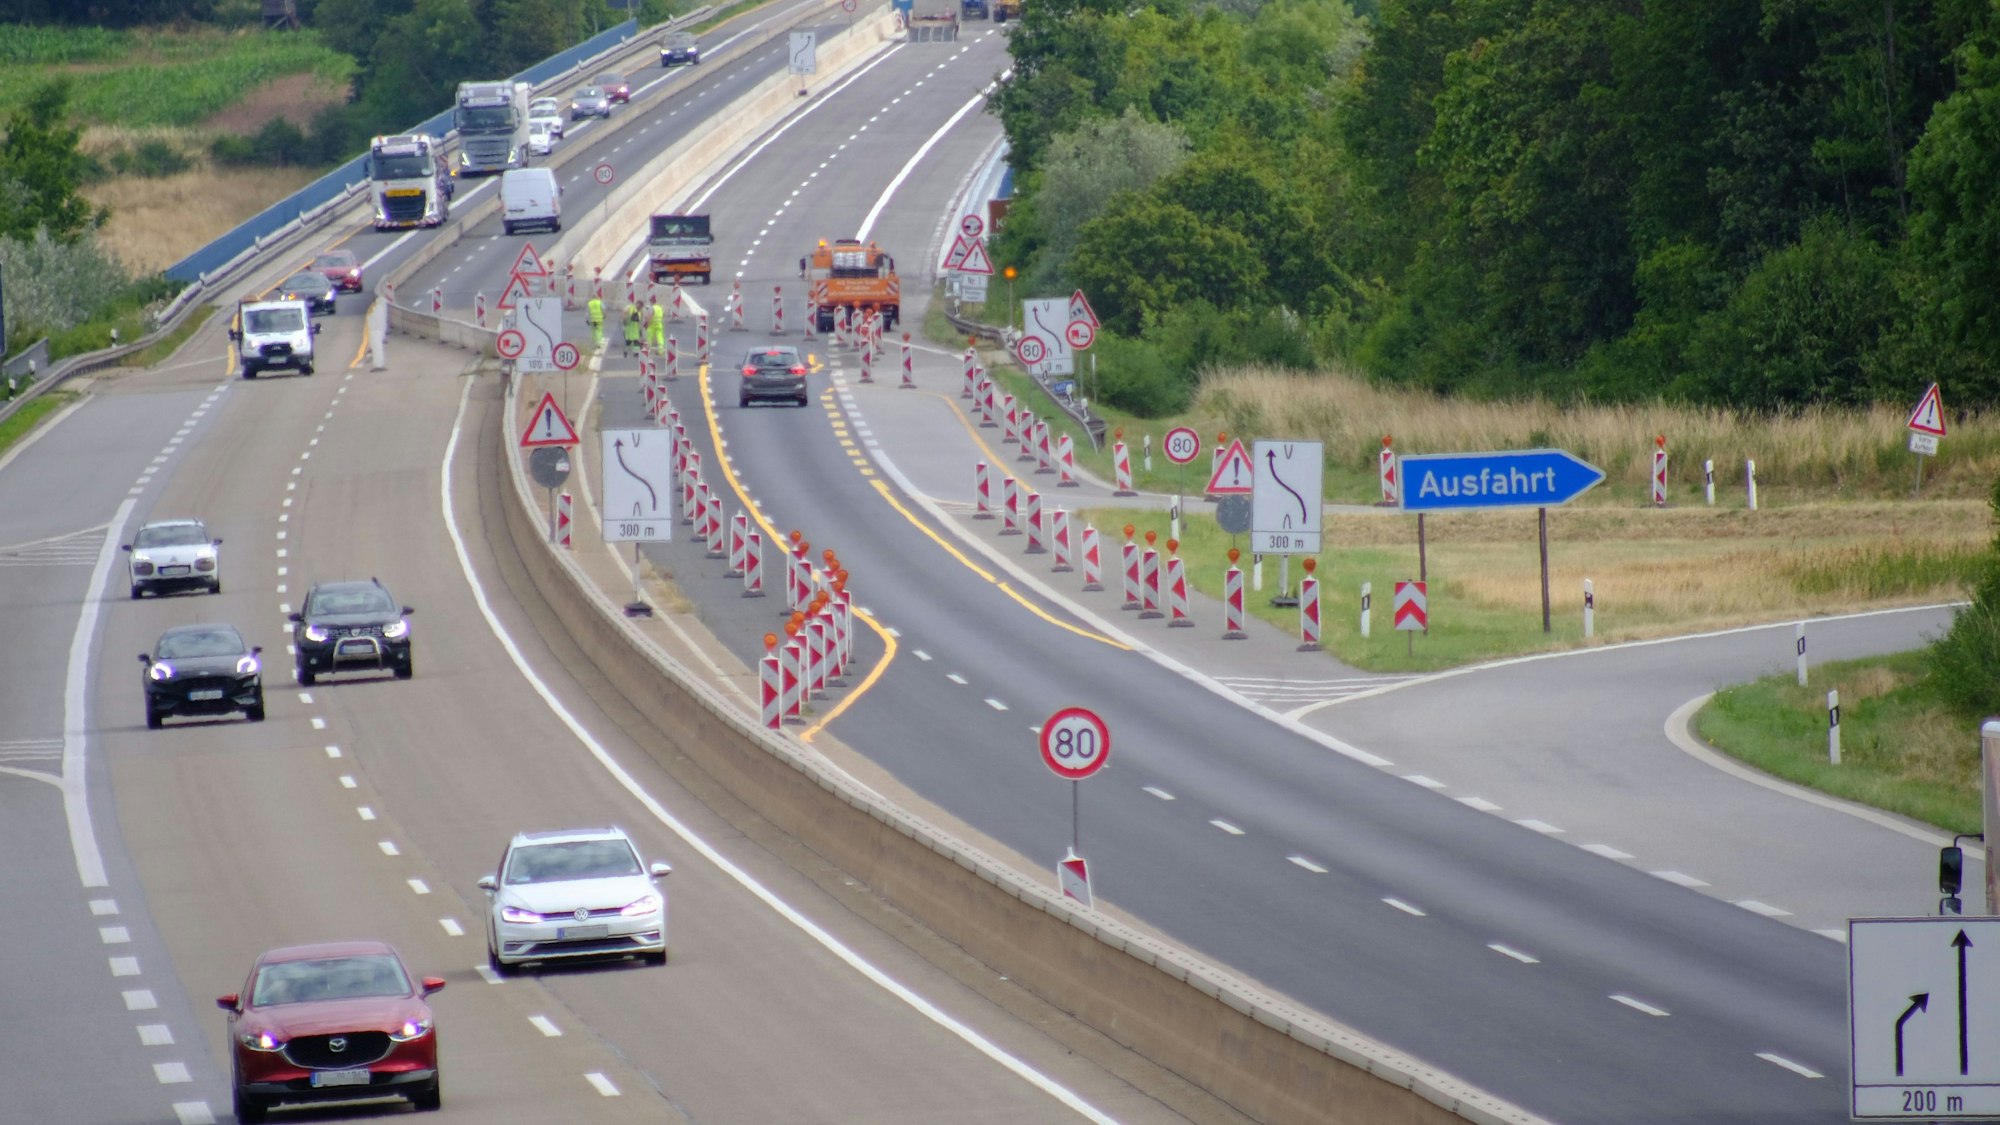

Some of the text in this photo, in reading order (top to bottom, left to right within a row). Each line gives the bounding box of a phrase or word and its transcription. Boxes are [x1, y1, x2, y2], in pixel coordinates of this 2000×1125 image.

[559, 350, 573, 363] 80
[1023, 344, 1039, 358] 80
[1173, 438, 1192, 453] 80
[1419, 466, 1556, 498] Ausfahrt
[620, 523, 655, 537] 300 m
[1270, 535, 1304, 549] 300 m
[1055, 728, 1095, 759] 80
[1902, 1090, 1963, 1112] 200 m
